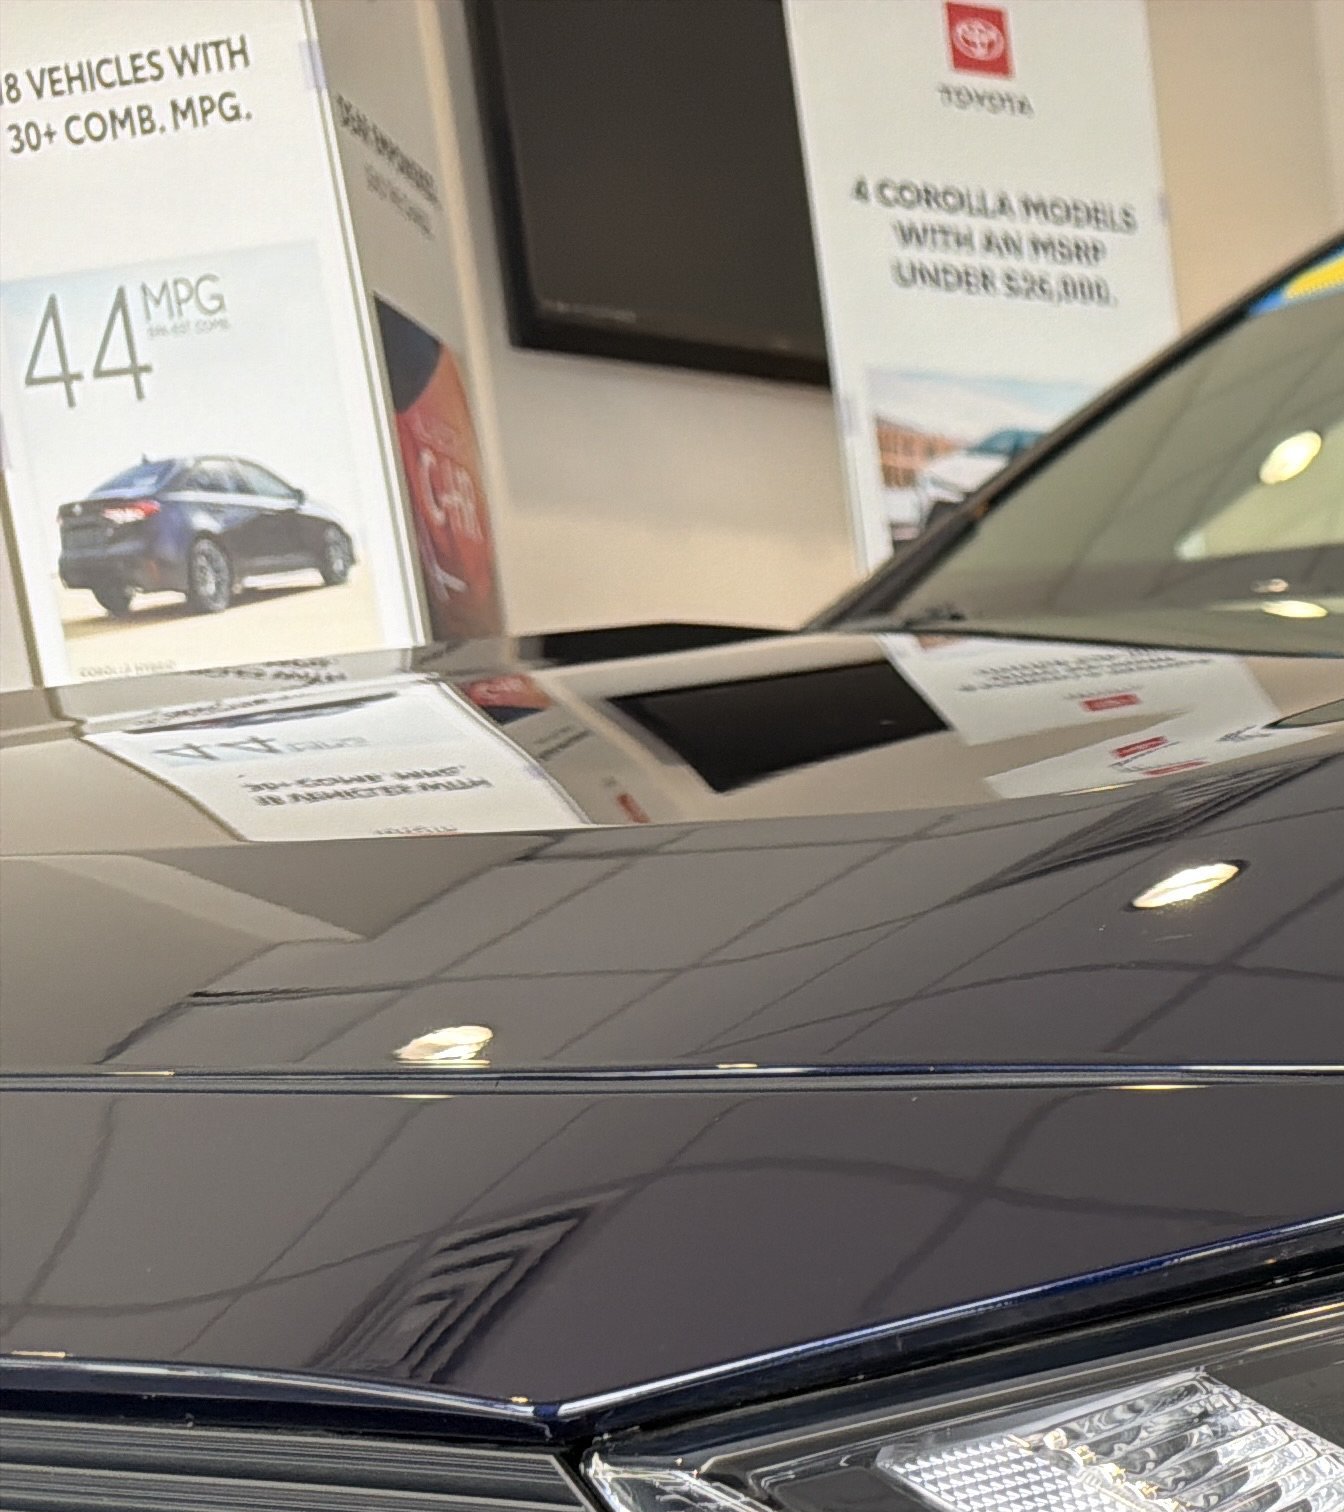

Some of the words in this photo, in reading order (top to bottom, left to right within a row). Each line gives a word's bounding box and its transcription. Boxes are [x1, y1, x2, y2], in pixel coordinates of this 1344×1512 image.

[25, 49, 164, 100] VEHICLES
[168, 34, 251, 78] WITH
[7, 120, 57, 155] 30+
[64, 107, 166, 146] COMB.
[171, 91, 253, 131] MPG.
[938, 83, 1034, 118] TOYOTA
[852, 174, 870, 204] 4
[874, 178, 1017, 221] COROLLA
[1018, 193, 1138, 235] MODELS
[893, 218, 978, 252] WITH
[980, 226, 1025, 258] AN
[1026, 232, 1108, 267] MSRP
[891, 256, 998, 297] UNDER
[24, 285, 153, 409] 44
[140, 273, 227, 321] MPG
